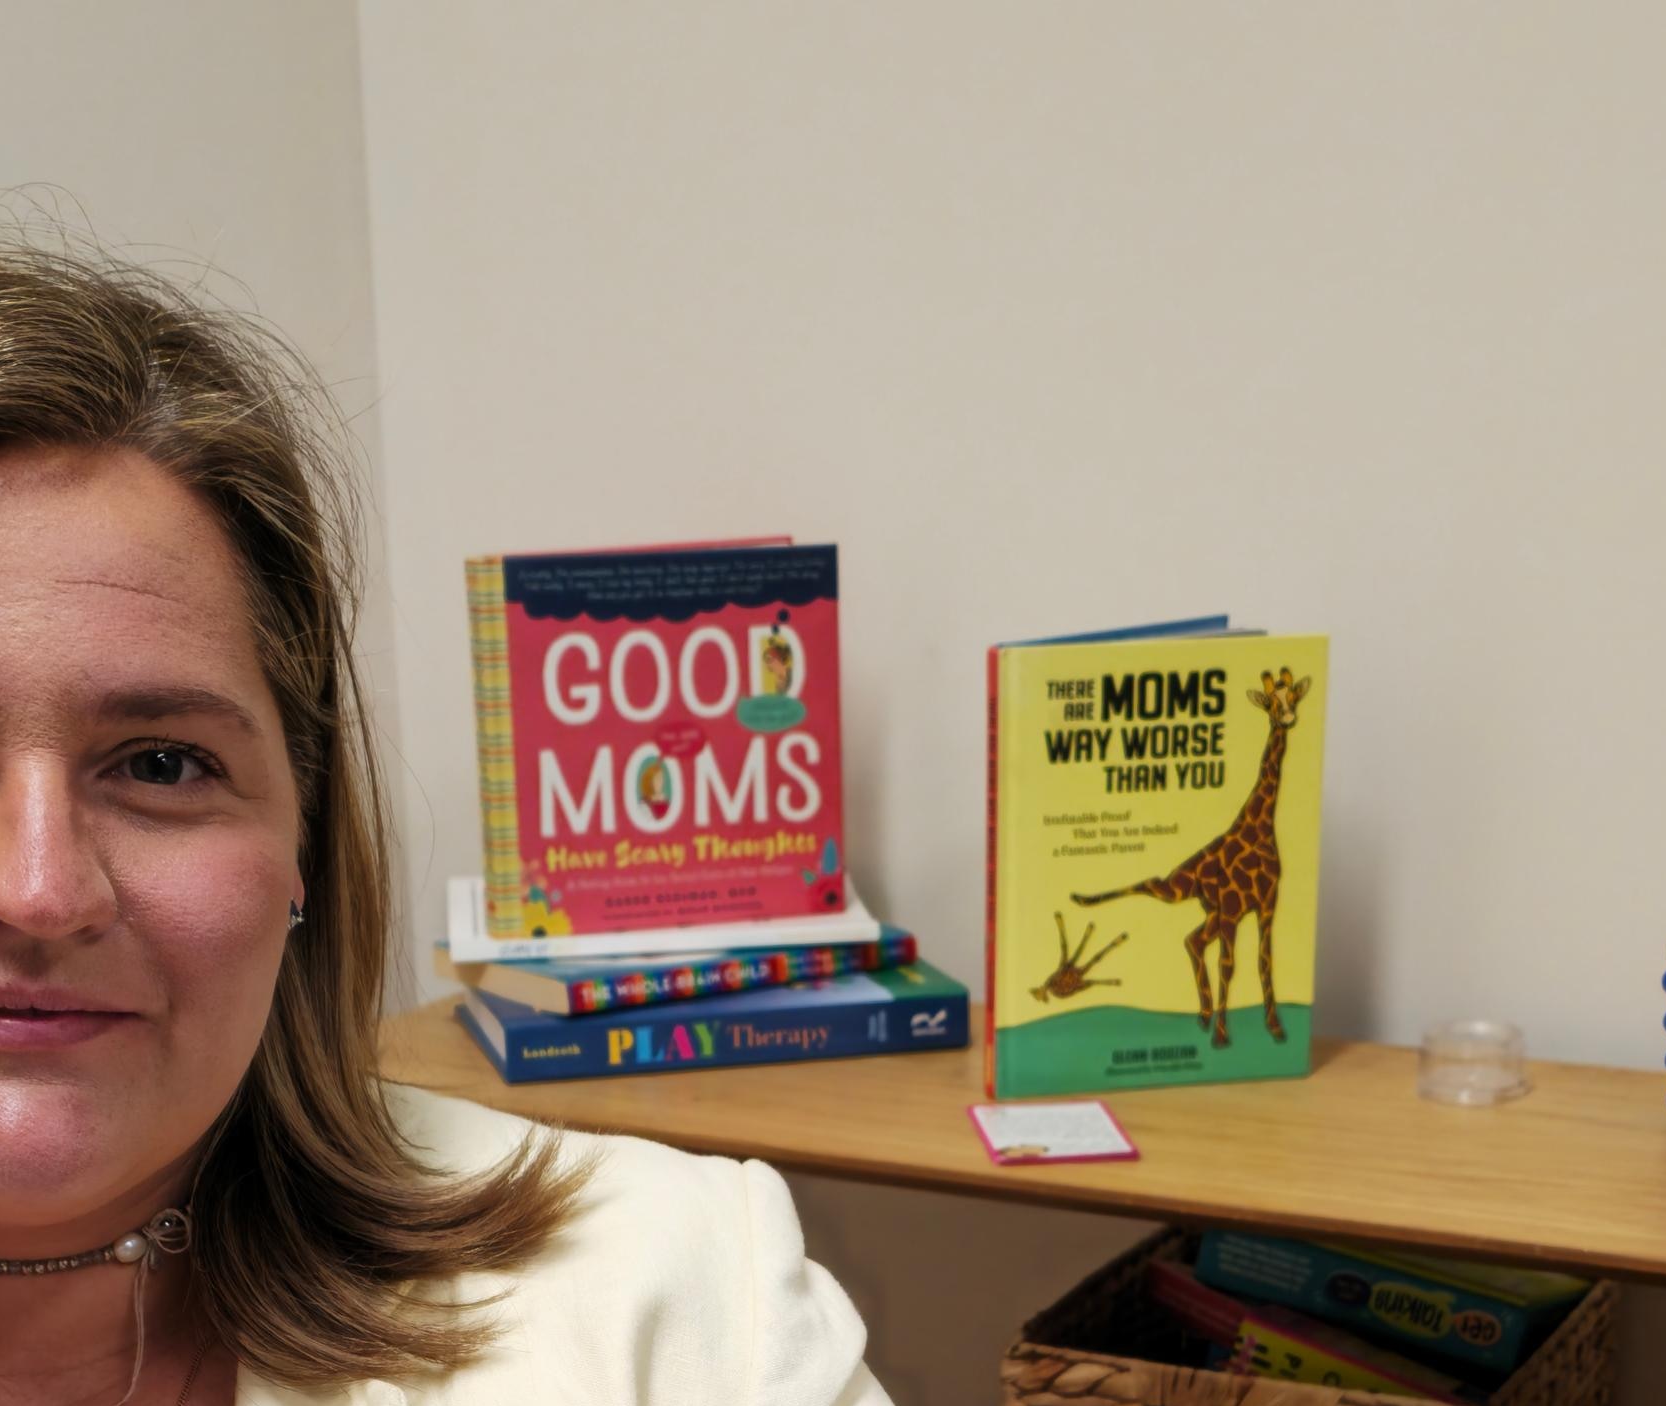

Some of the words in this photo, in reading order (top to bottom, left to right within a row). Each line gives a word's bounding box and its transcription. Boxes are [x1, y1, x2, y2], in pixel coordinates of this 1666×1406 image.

[543, 624, 806, 725] GOOD
[1047, 679, 1095, 701] THERE
[1101, 668, 1227, 722] MOMS
[1064, 701, 1094, 721] ARE
[1044, 728, 1112, 764] WAY
[1121, 722, 1225, 760] WORSE
[538, 732, 821, 838] MOMS
[1104, 764, 1167, 794] THAN
[1175, 761, 1225, 789] YOU
[546, 847, 608, 873] Have
[615, 840, 686, 869] Scary
[693, 831, 816, 862] Thoughts
[580, 985, 611, 1003] THE
[723, 963, 770, 985] CHILD
[607, 1021, 720, 1066] PLAY
[727, 1023, 830, 1049] Therapy
